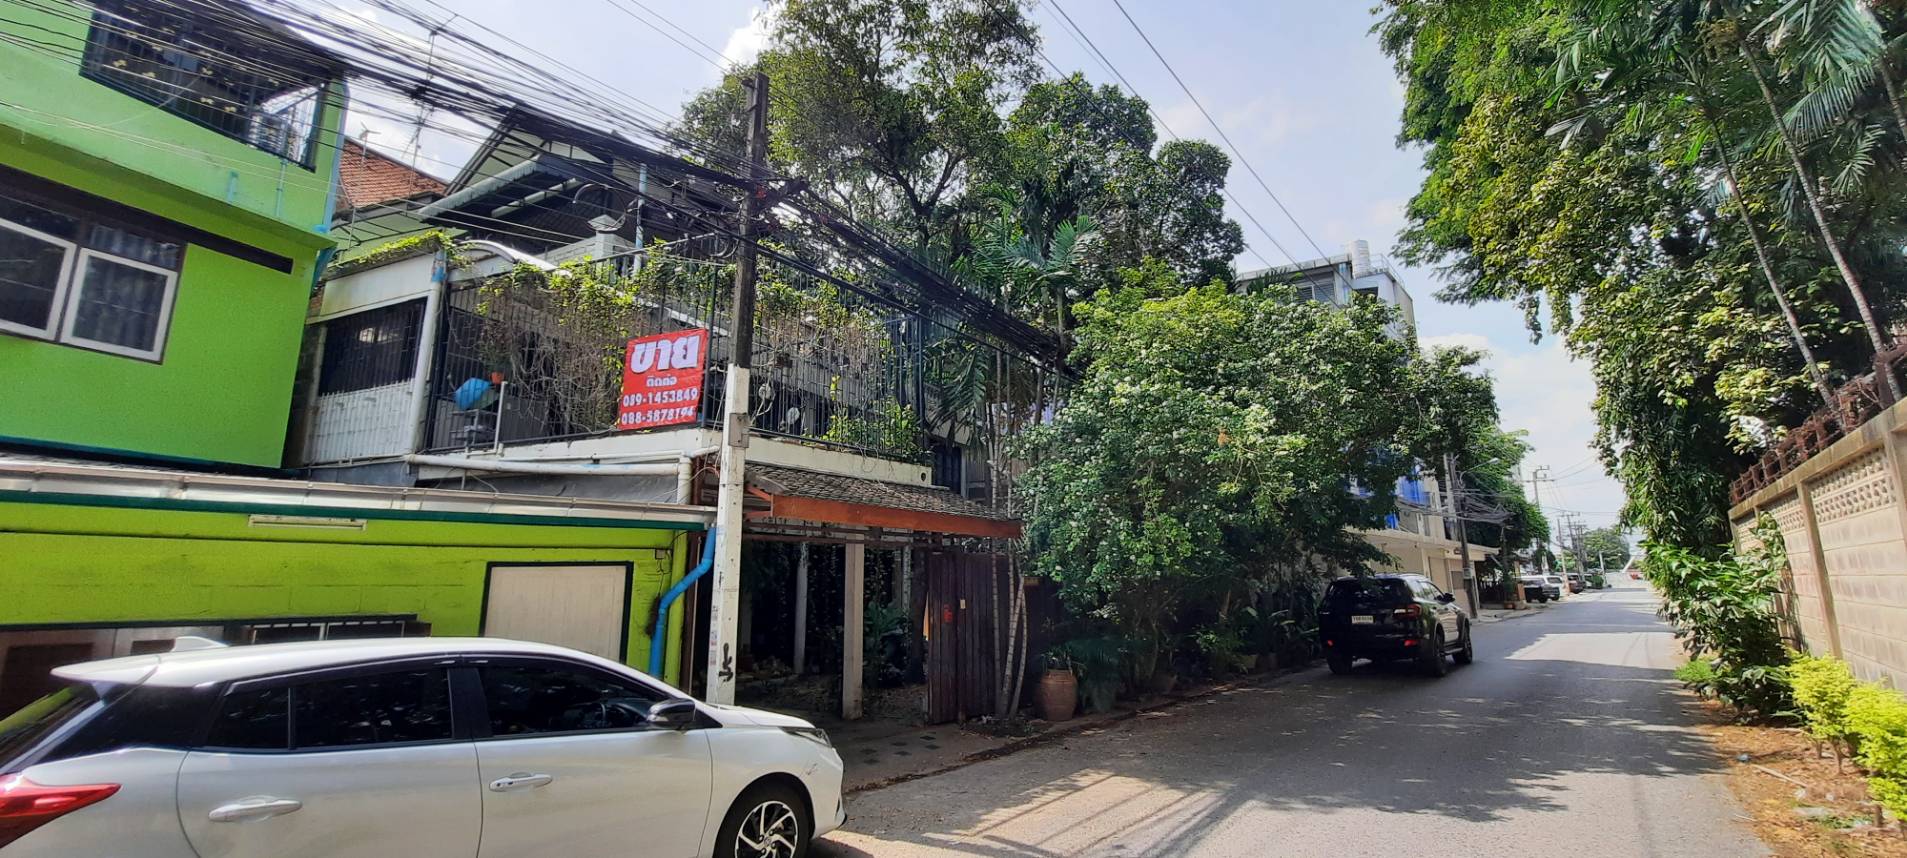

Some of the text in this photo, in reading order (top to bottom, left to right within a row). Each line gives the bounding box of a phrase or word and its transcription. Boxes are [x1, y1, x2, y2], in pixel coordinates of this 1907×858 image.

[631, 336, 699, 373] ขาย
[646, 374, 677, 387] ติดต่อ
